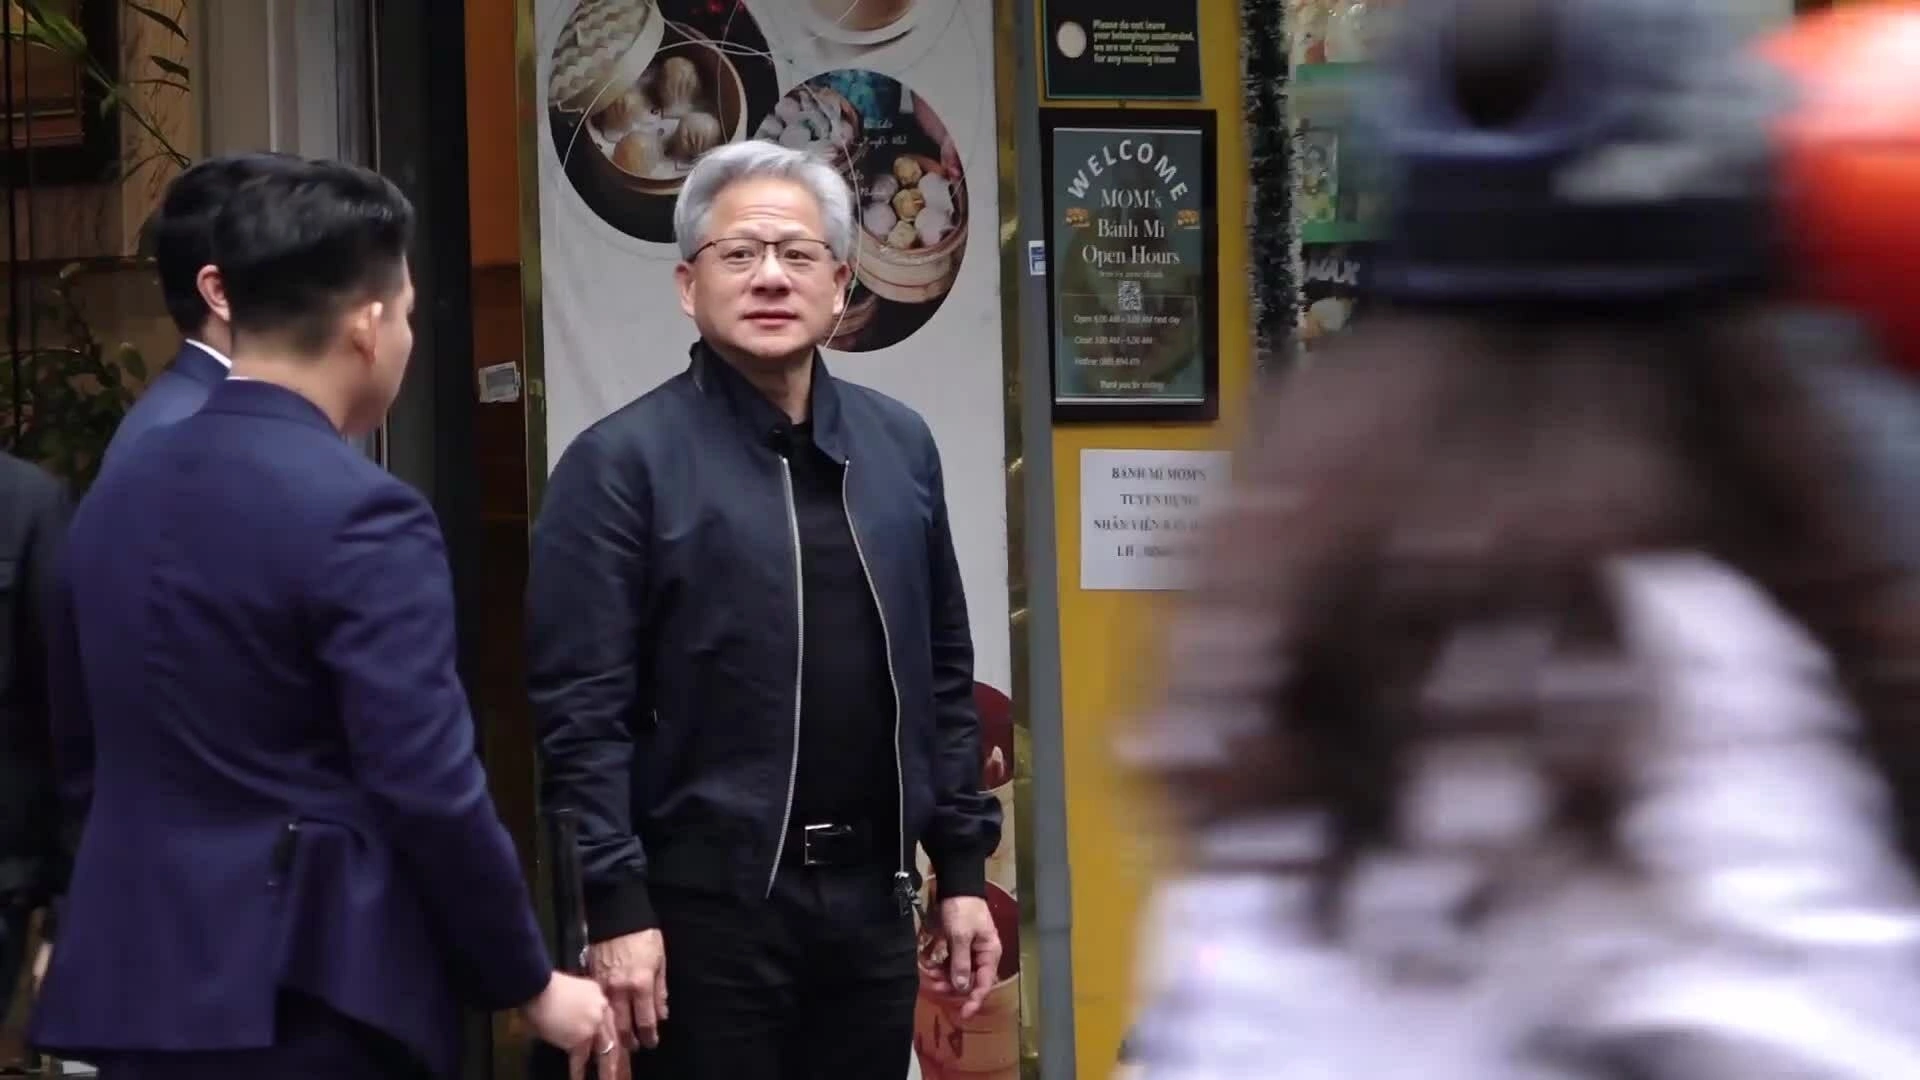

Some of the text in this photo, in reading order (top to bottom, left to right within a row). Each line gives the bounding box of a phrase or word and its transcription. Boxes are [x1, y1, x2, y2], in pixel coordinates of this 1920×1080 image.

[1093, 19, 1166, 30] Please do not leave
[1094, 32, 1111, 42] your
[1111, 31, 1150, 43] belongings
[1119, 44, 1133, 52] not
[1134, 43, 1180, 54] responsible
[1094, 53, 1106, 63] for
[1107, 55, 1122, 66] any
[1123, 54, 1153, 66] missing
[1067, 139, 1189, 201] WELCOME
[1101, 188, 1162, 209] MOM's
[1082, 245, 1180, 268] Open Hours
[1101, 380, 1117, 389] Thank
[1119, 382, 1132, 391] you
